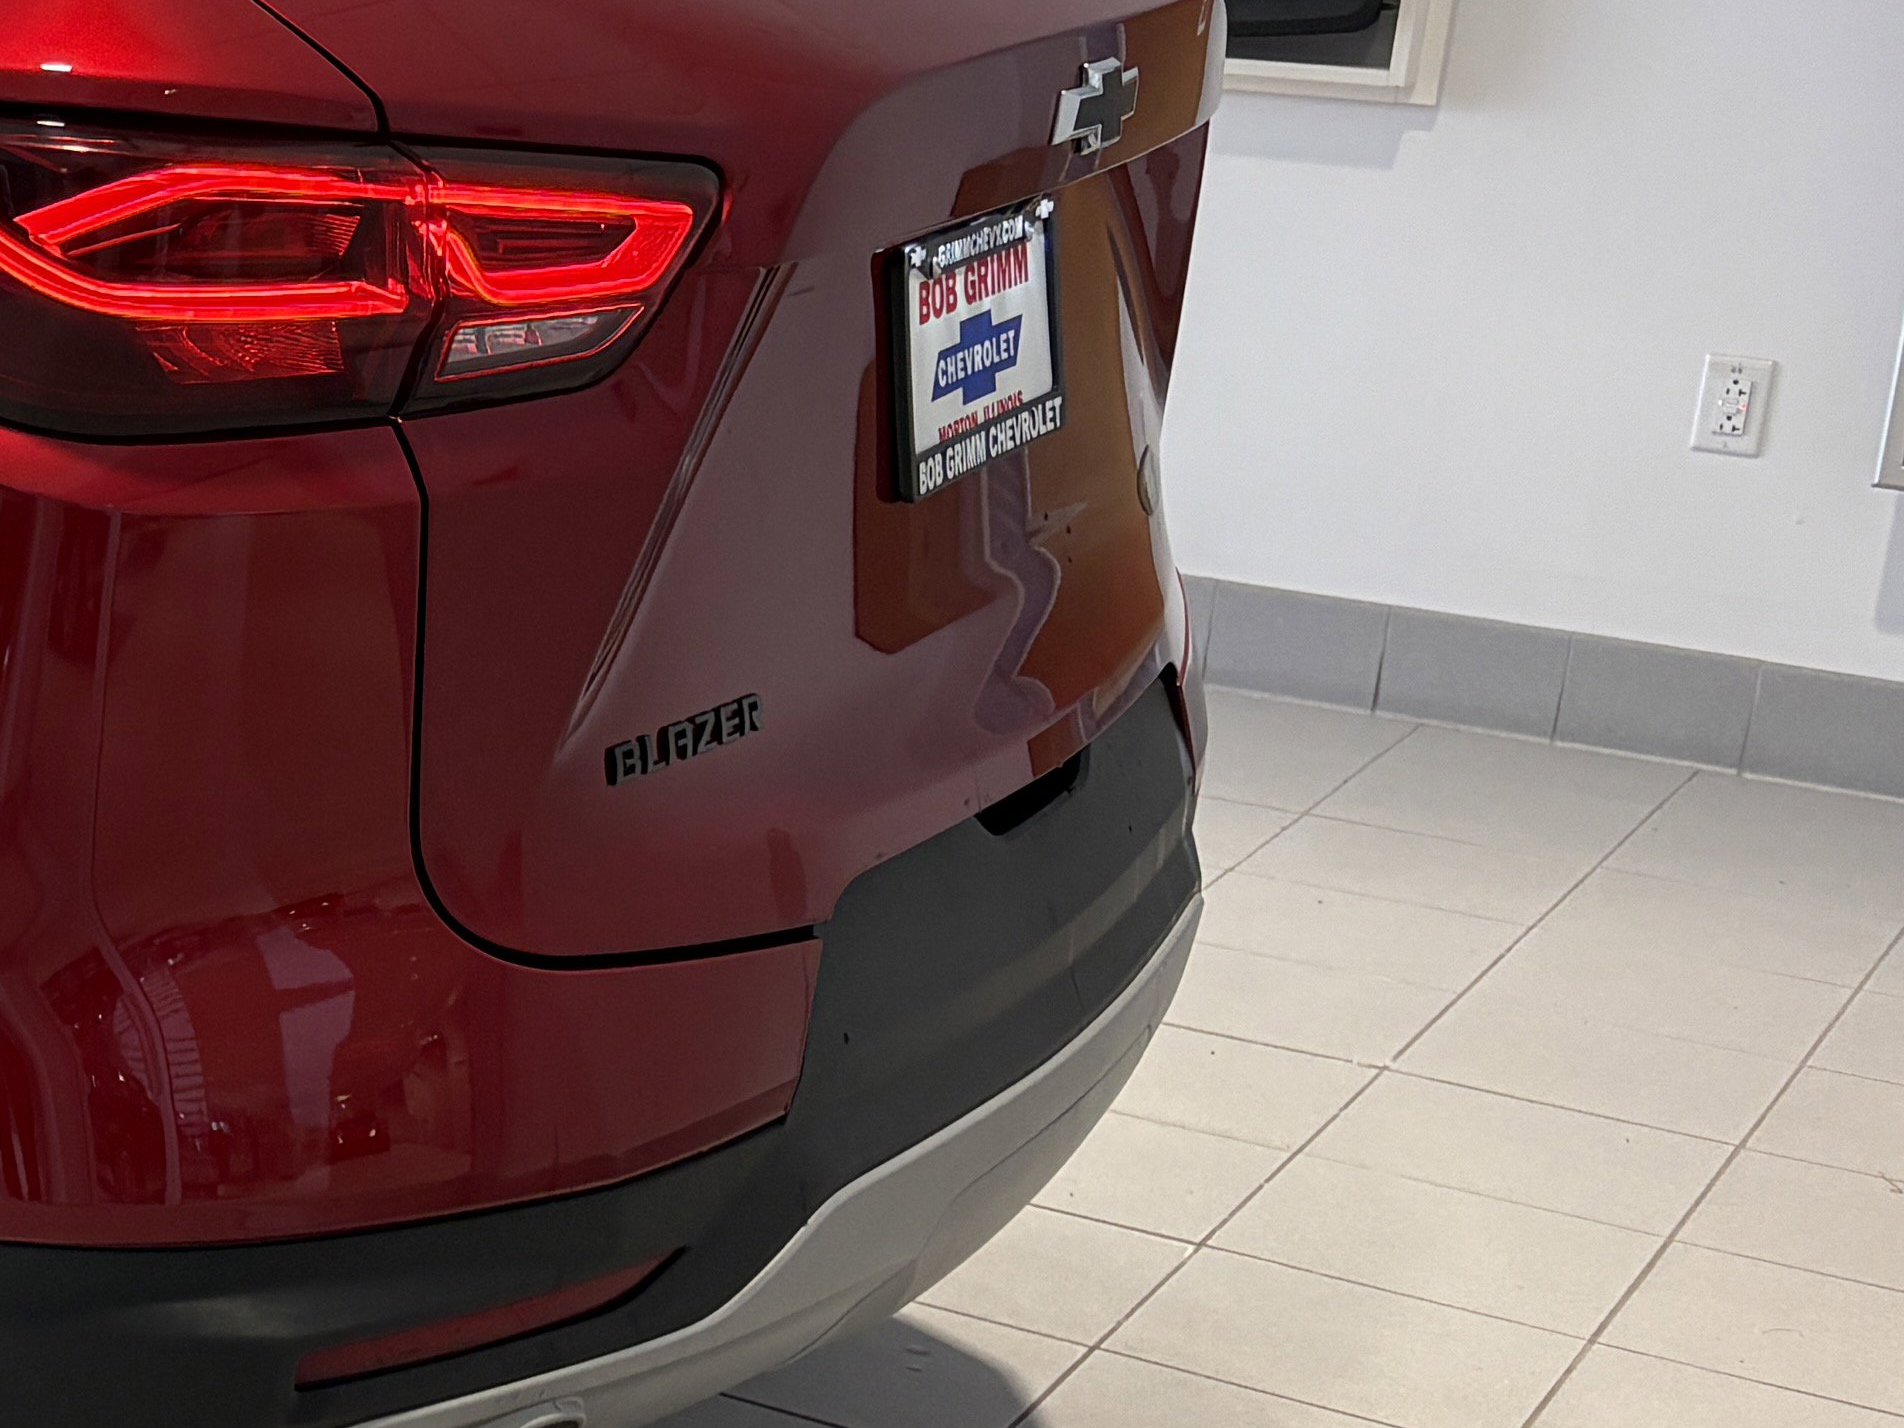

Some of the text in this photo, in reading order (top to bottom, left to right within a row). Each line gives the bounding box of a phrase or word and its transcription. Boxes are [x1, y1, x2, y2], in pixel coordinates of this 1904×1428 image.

[919, 243, 1030, 326] BOB GRIMM
[937, 329, 1016, 388] CHEVROLET
[918, 396, 1064, 495] BOB GRIMM CHEVROLET
[605, 692, 763, 786] BLAZER
